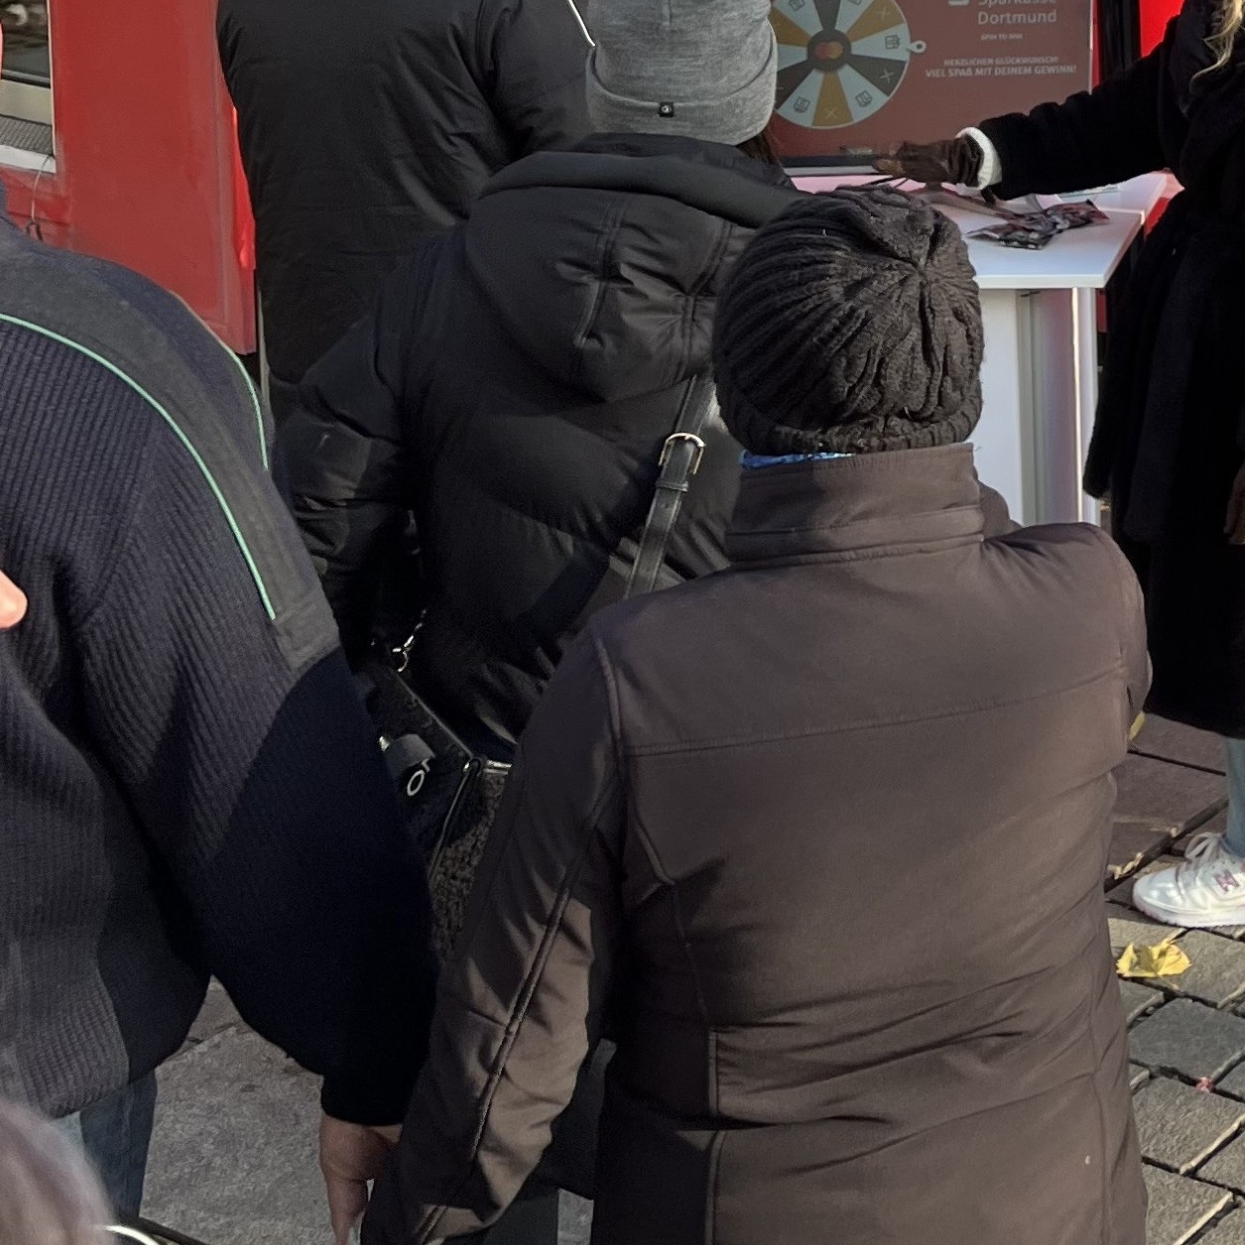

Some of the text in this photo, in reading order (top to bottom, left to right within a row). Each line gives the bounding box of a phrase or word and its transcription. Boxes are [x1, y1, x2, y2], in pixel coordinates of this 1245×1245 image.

[978, 9, 1057, 25] Dortmund
[925, 68, 945, 78] VIEL
[975, 66, 992, 76] MIT
[994, 65, 1032, 75] DEINEM
[1034, 64, 1076, 75] GEWINN!
